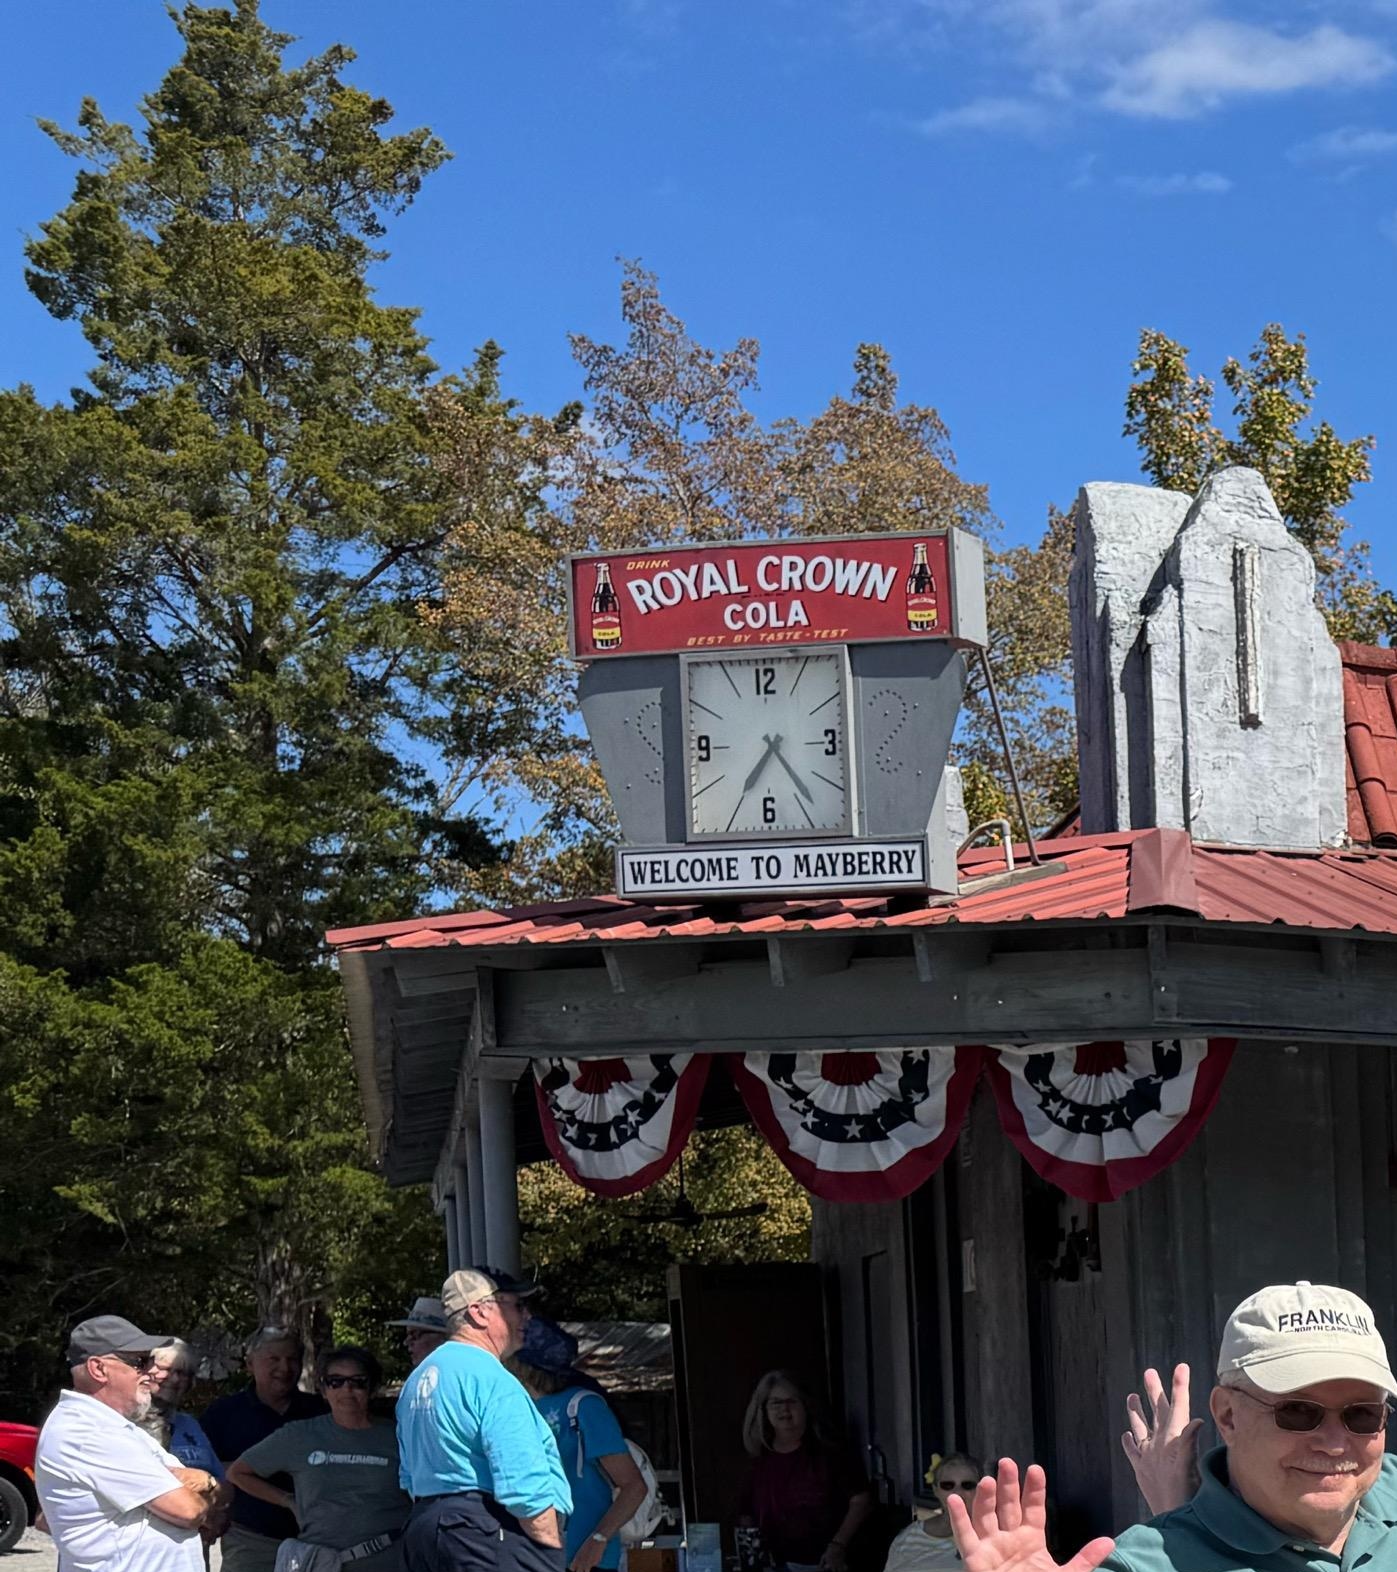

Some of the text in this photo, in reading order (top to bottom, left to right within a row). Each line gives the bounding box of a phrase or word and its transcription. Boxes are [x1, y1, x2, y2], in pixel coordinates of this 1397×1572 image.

[626, 559, 671, 571] DRINK
[626, 555, 898, 615] ROYAL CROWN
[723, 599, 810, 630] COLA
[687, 635, 726, 646] BEST
[733, 634, 751, 643] BY
[755, 667, 776, 695] 12
[697, 729, 837, 762] 9 3
[763, 796, 775, 823] 6
[629, 849, 916, 885] WELCOME TO MAYBERRY
[1278, 1308, 1372, 1336] FRANKLIN
[1294, 1325, 1323, 1333] NORTH
